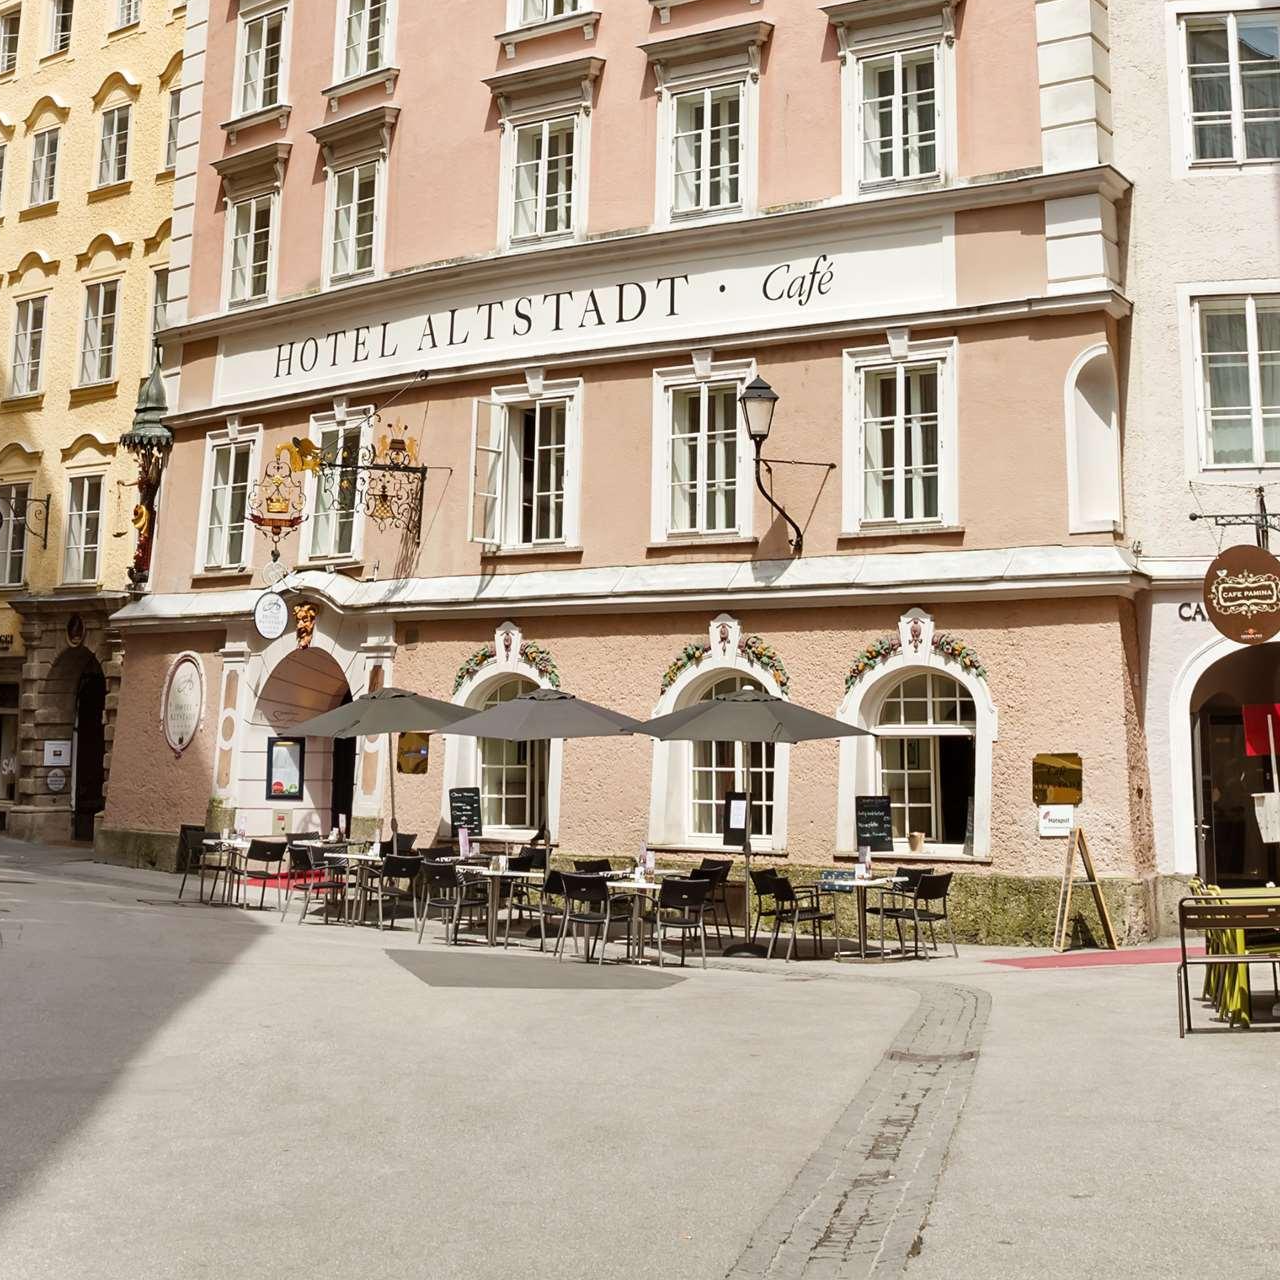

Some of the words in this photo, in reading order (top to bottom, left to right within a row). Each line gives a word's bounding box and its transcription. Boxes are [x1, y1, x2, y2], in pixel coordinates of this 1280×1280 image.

[273, 321, 398, 379] HOTEL
[416, 273, 690, 352] ALTSTADT
[761, 253, 834, 307] Café
[1222, 590, 1243, 598] CAFE
[1243, 589, 1273, 597] PAMINA
